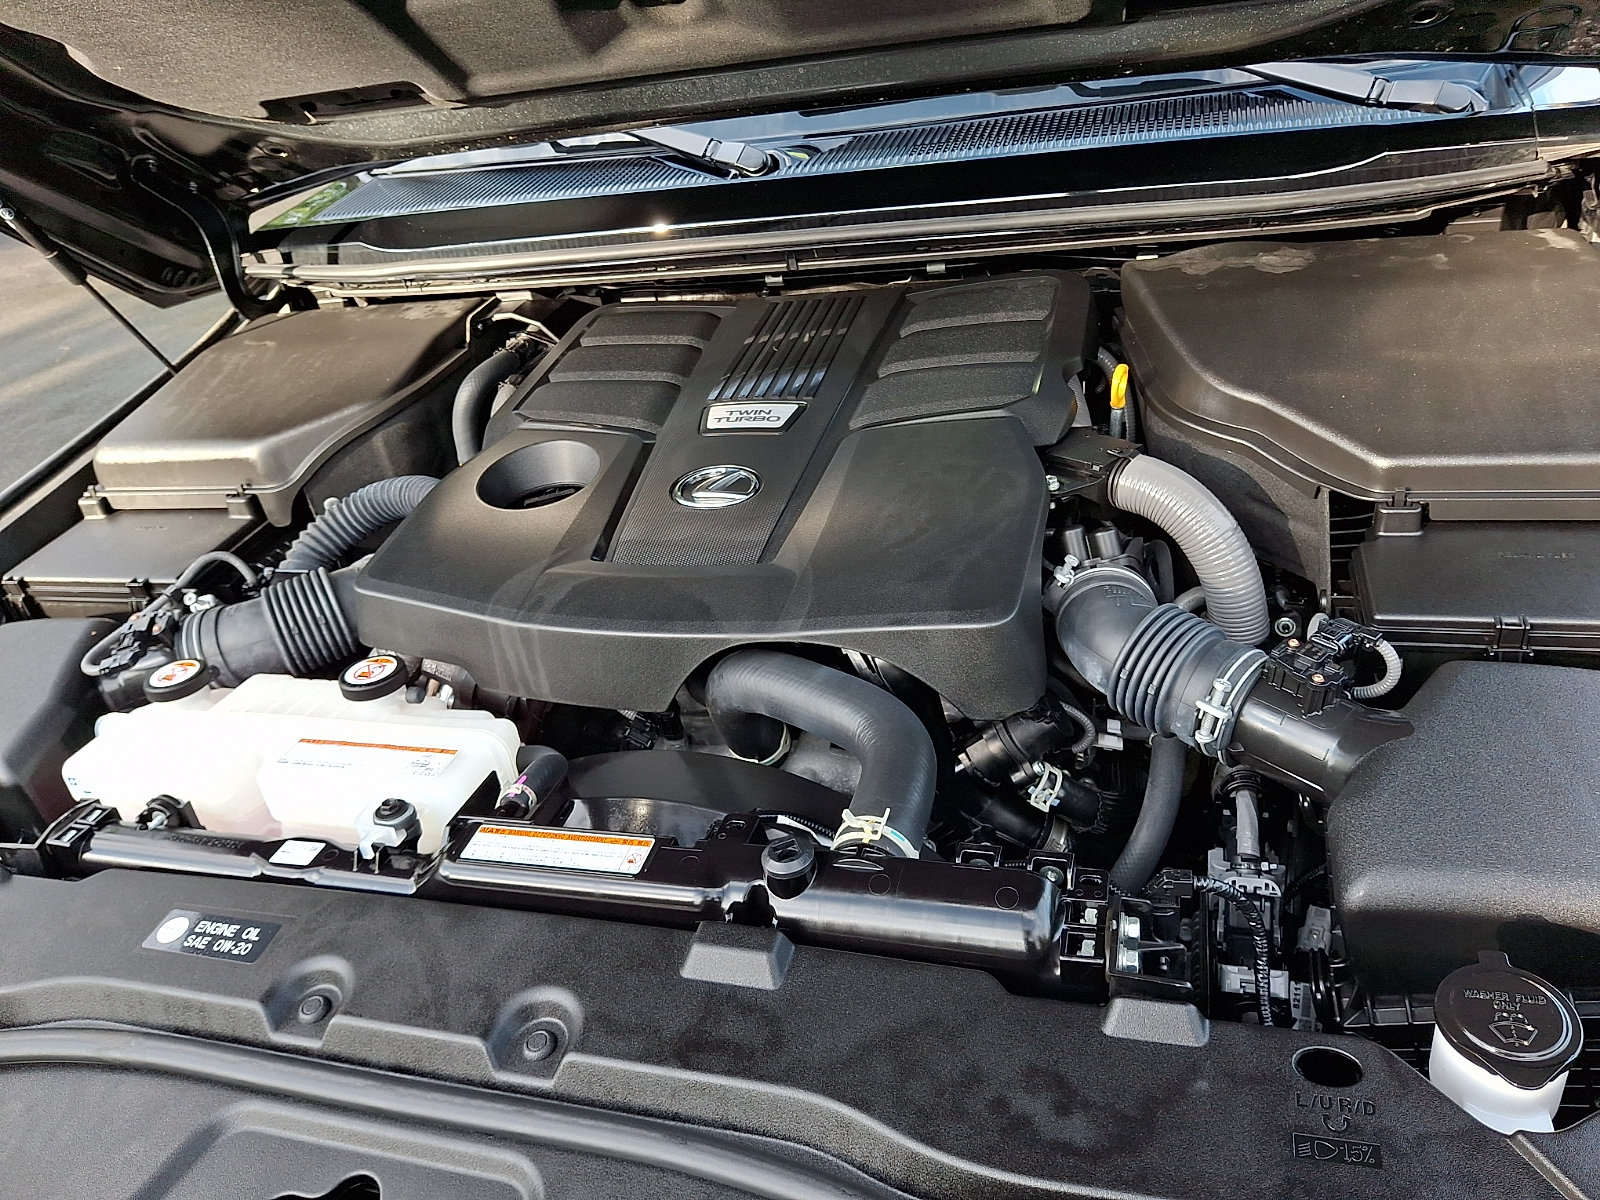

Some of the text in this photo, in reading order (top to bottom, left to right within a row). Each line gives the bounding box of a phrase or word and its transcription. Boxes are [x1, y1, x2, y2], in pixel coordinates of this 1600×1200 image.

[194, 920, 262, 941] ENGINE OIL
[183, 935, 253, 956] SAE 0W-20
[1463, 989, 1547, 1005] WASHER FLUID
[1493, 1002, 1521, 1011] ONLY
